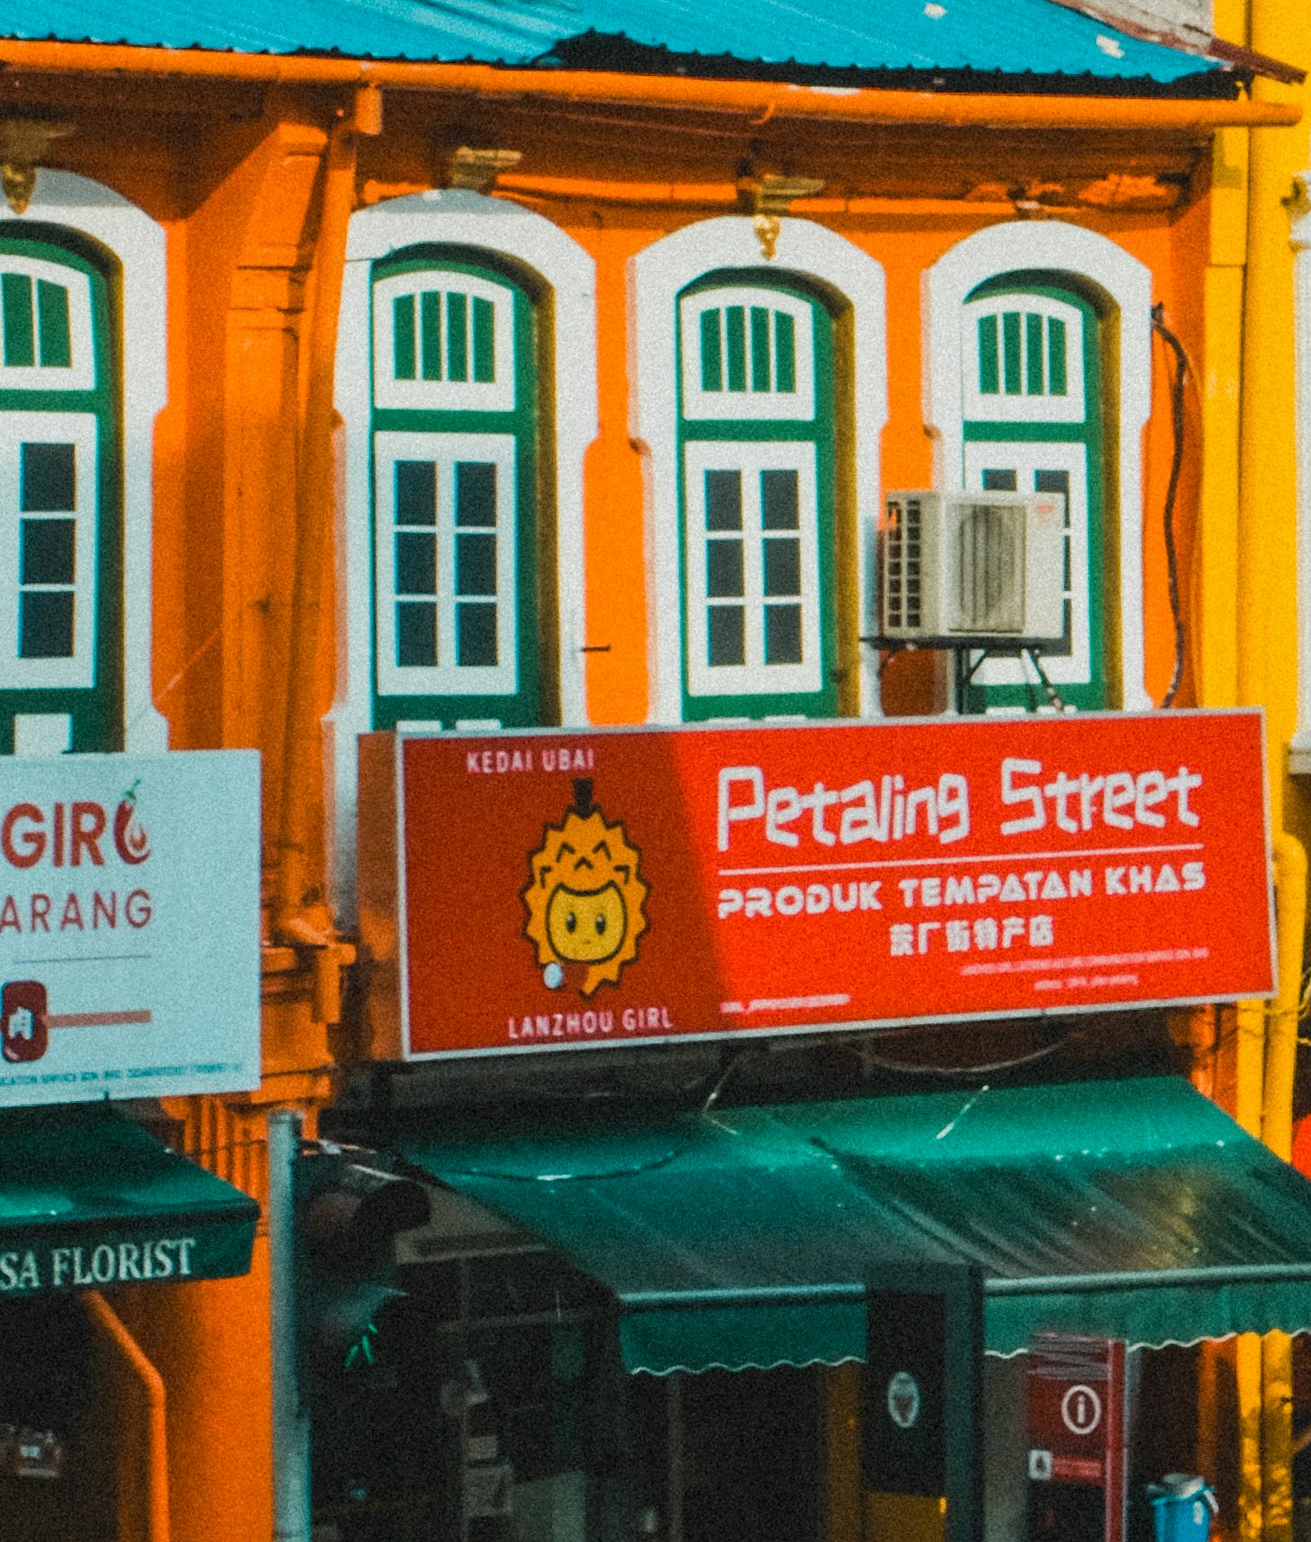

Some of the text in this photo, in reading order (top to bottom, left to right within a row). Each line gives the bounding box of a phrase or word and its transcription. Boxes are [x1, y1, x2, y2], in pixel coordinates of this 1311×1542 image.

[466, 747, 595, 774] KEDAI UBAI
[717, 757, 1203, 853] Petaling Street
[717, 861, 1207, 920] PRODUK TEMPATAN KHAS
[507, 1006, 674, 1039] LANZHOU GIRL
[52, 1237, 196, 1286] FLORIST
